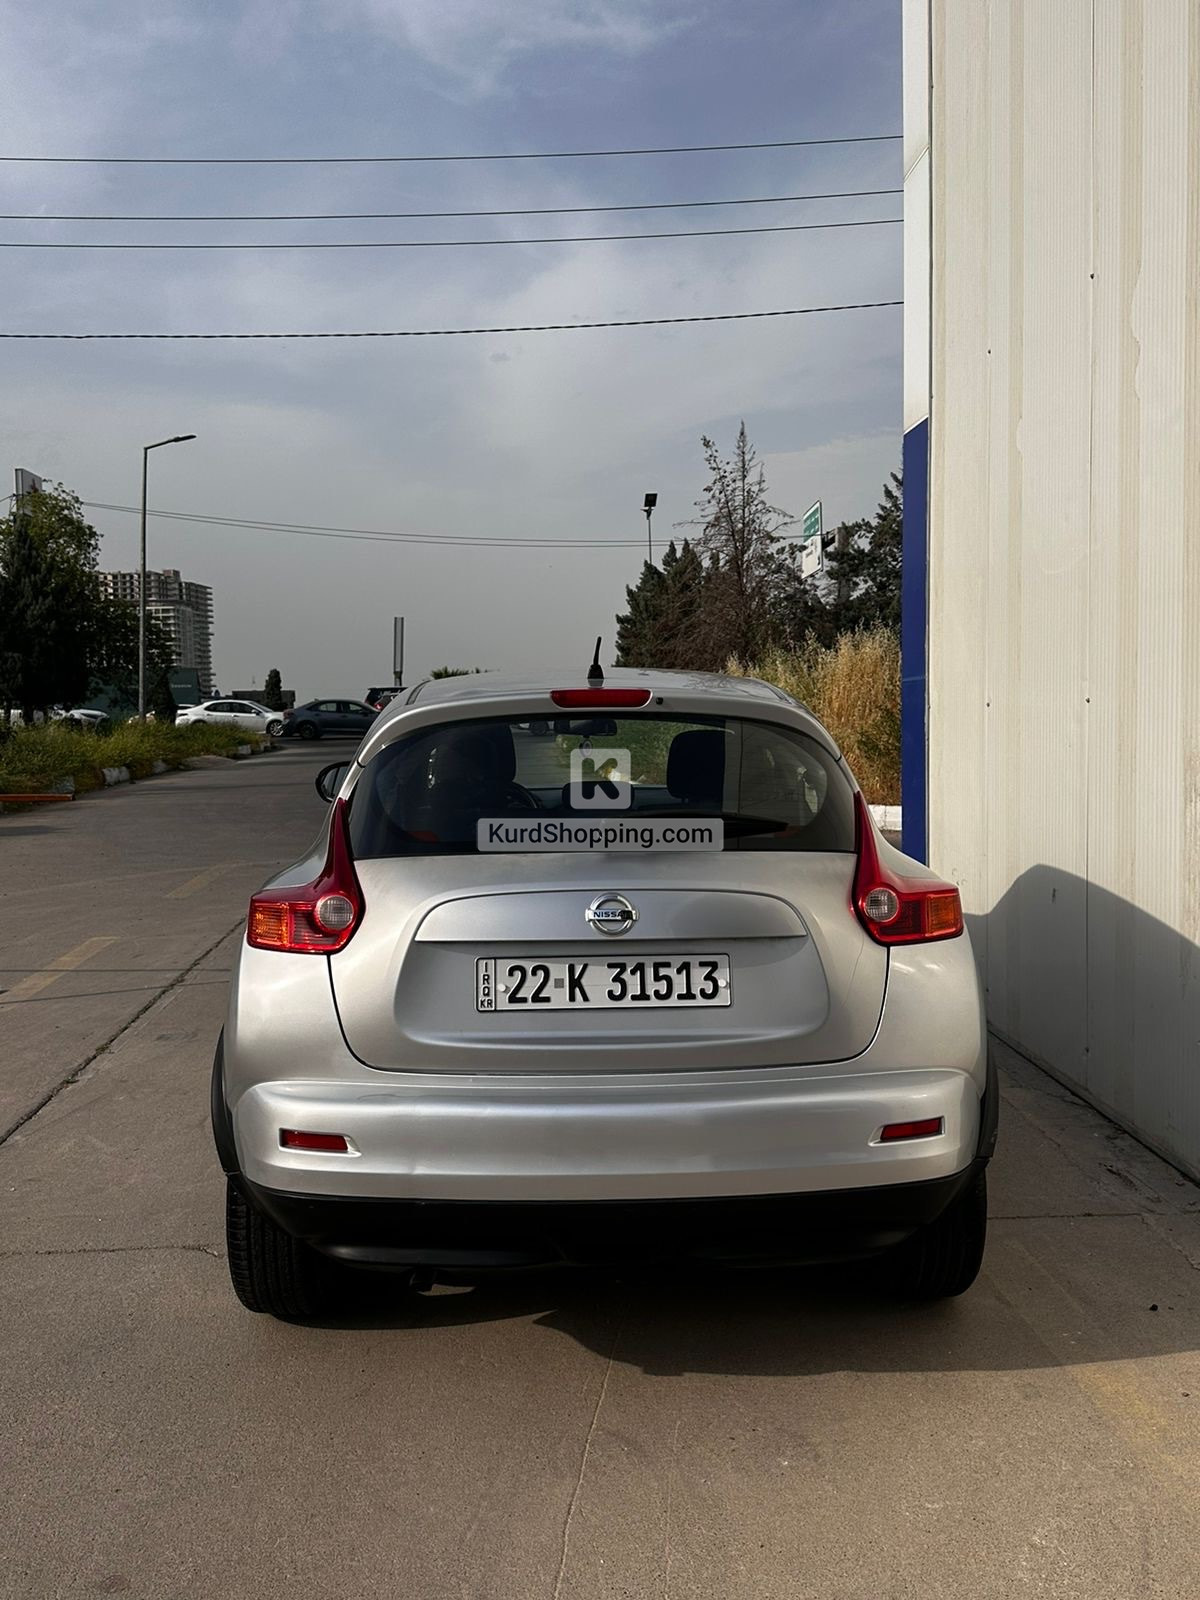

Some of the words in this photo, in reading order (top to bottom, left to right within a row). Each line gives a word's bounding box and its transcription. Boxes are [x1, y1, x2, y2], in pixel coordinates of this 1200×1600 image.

[593, 911, 632, 919] NISSA
[507, 964, 551, 1004] 22
[567, 962, 590, 1003] K
[606, 961, 719, 1002] 31513
[480, 998, 493, 1009] KR
